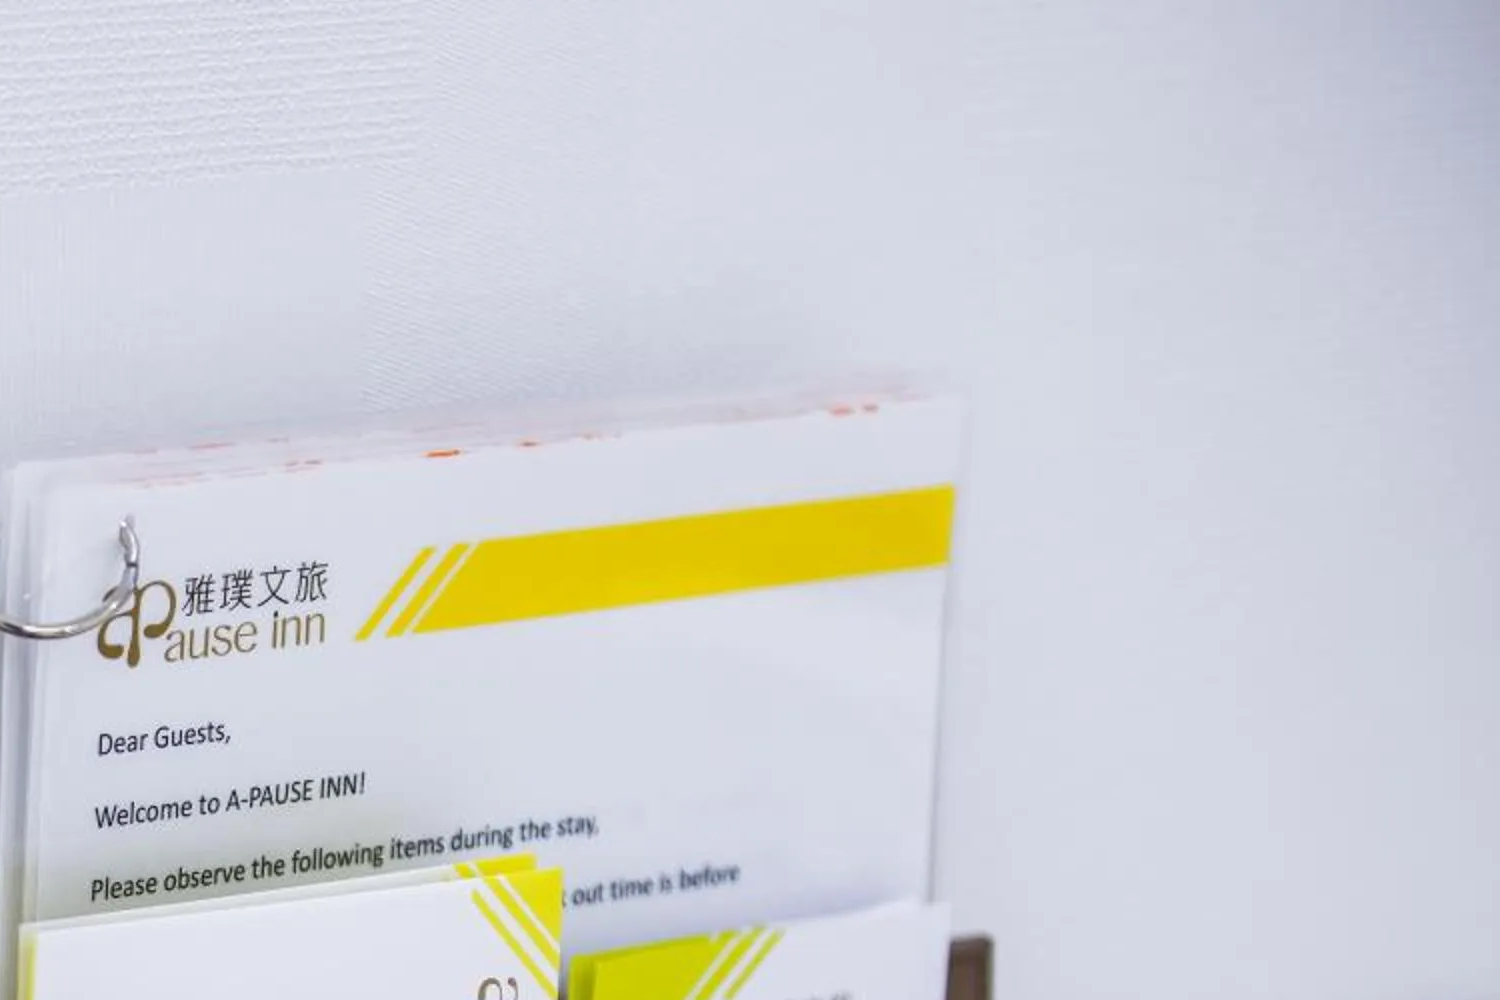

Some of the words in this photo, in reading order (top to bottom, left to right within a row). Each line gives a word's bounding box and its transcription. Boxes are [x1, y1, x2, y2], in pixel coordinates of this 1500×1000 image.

[182, 560, 329, 617] 雅璞文旅
[272, 610, 326, 650] inn
[97, 732, 149, 757] Dear
[153, 721, 232, 749] Guests,
[94, 799, 193, 829] Welcome
[199, 794, 220, 816] to
[225, 778, 315, 812] A-PAUSE
[319, 771, 367, 799] INN!
[90, 876, 158, 902] Please
[163, 867, 246, 891] observe
[251, 855, 286, 880] the
[291, 842, 385, 875] following
[389, 836, 445, 860] items
[450, 825, 514, 852] during
[520, 818, 551, 840] the
[572, 882, 603, 907] out
[609, 876, 652, 900] time
[659, 872, 673, 896] is
[678, 861, 741, 892] before
